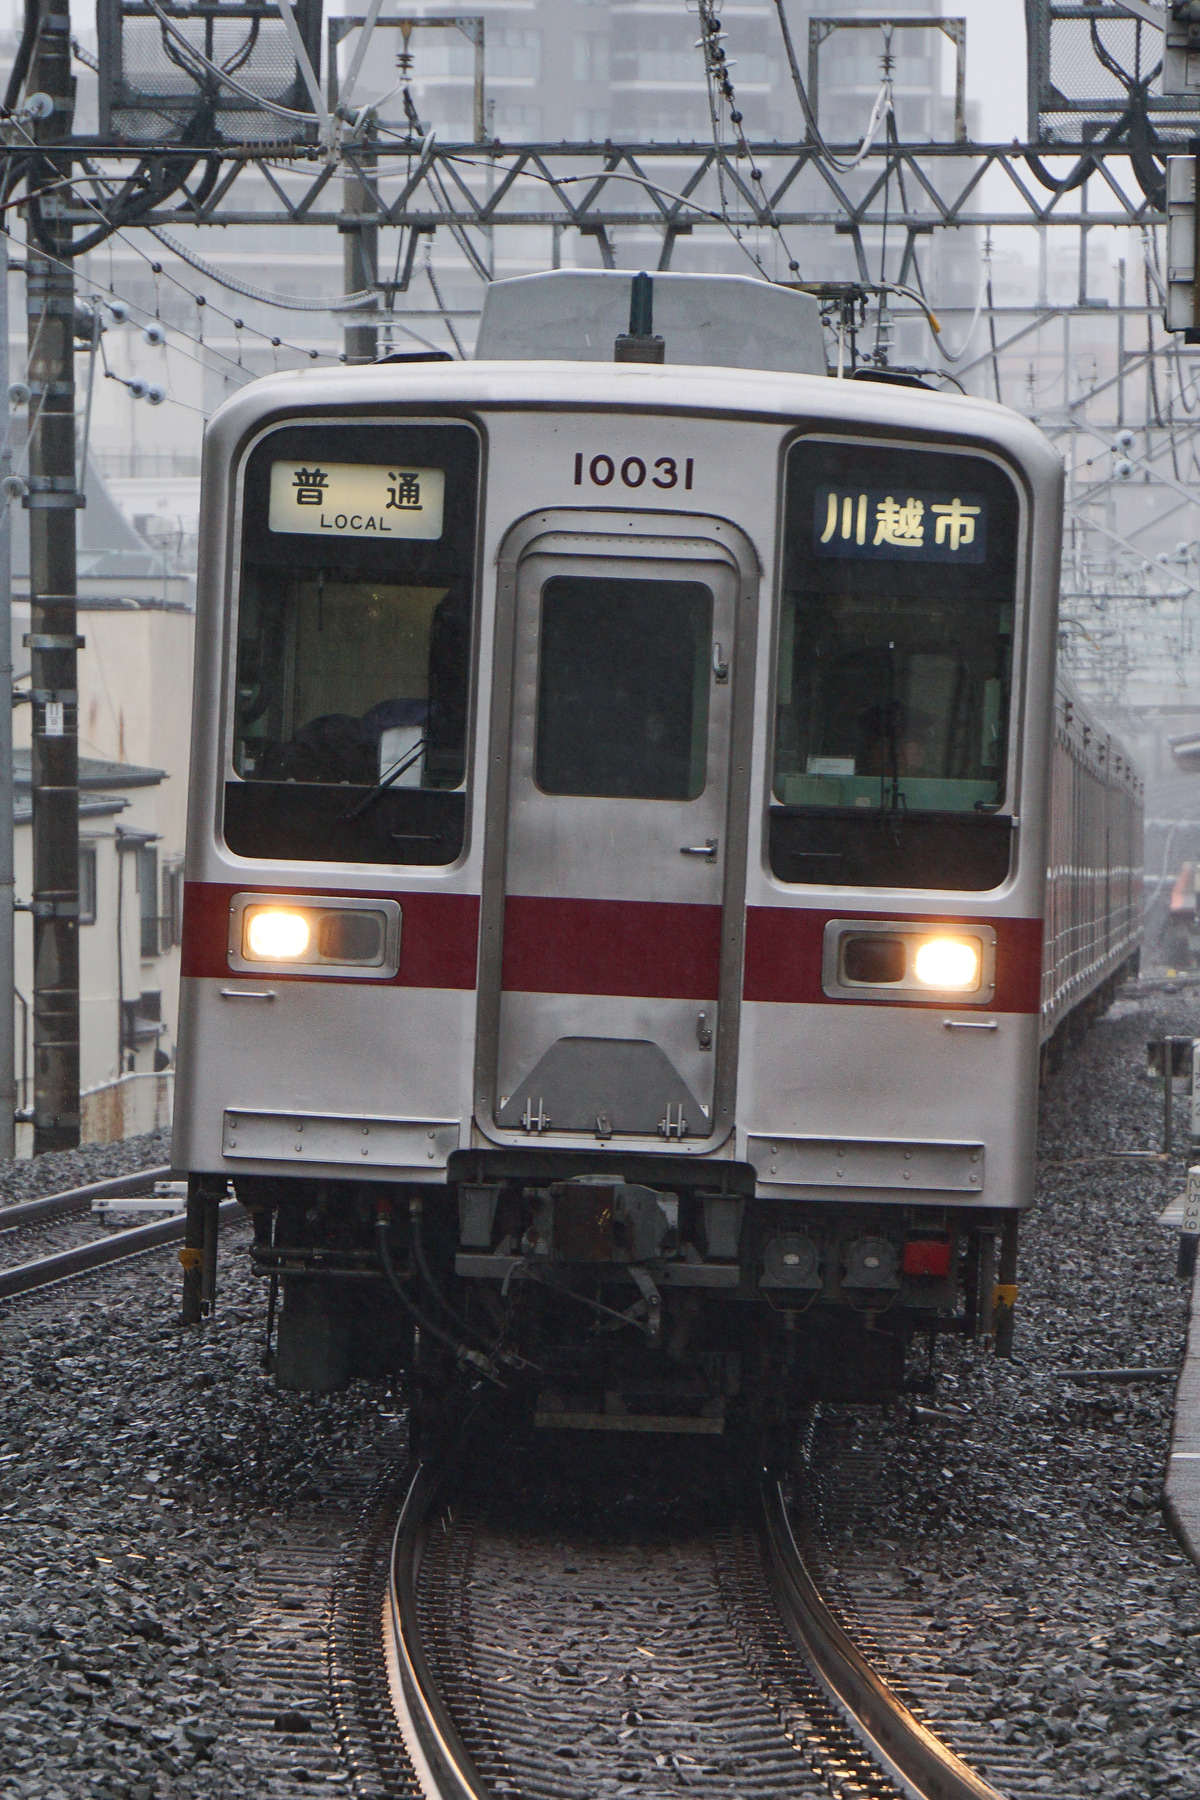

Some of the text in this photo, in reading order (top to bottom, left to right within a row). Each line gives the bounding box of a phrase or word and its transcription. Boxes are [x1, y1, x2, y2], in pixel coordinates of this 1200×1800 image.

[574, 452, 694, 490] 10031
[320, 513, 392, 532] LOCAL
[820, 493, 981, 551] 川越市
